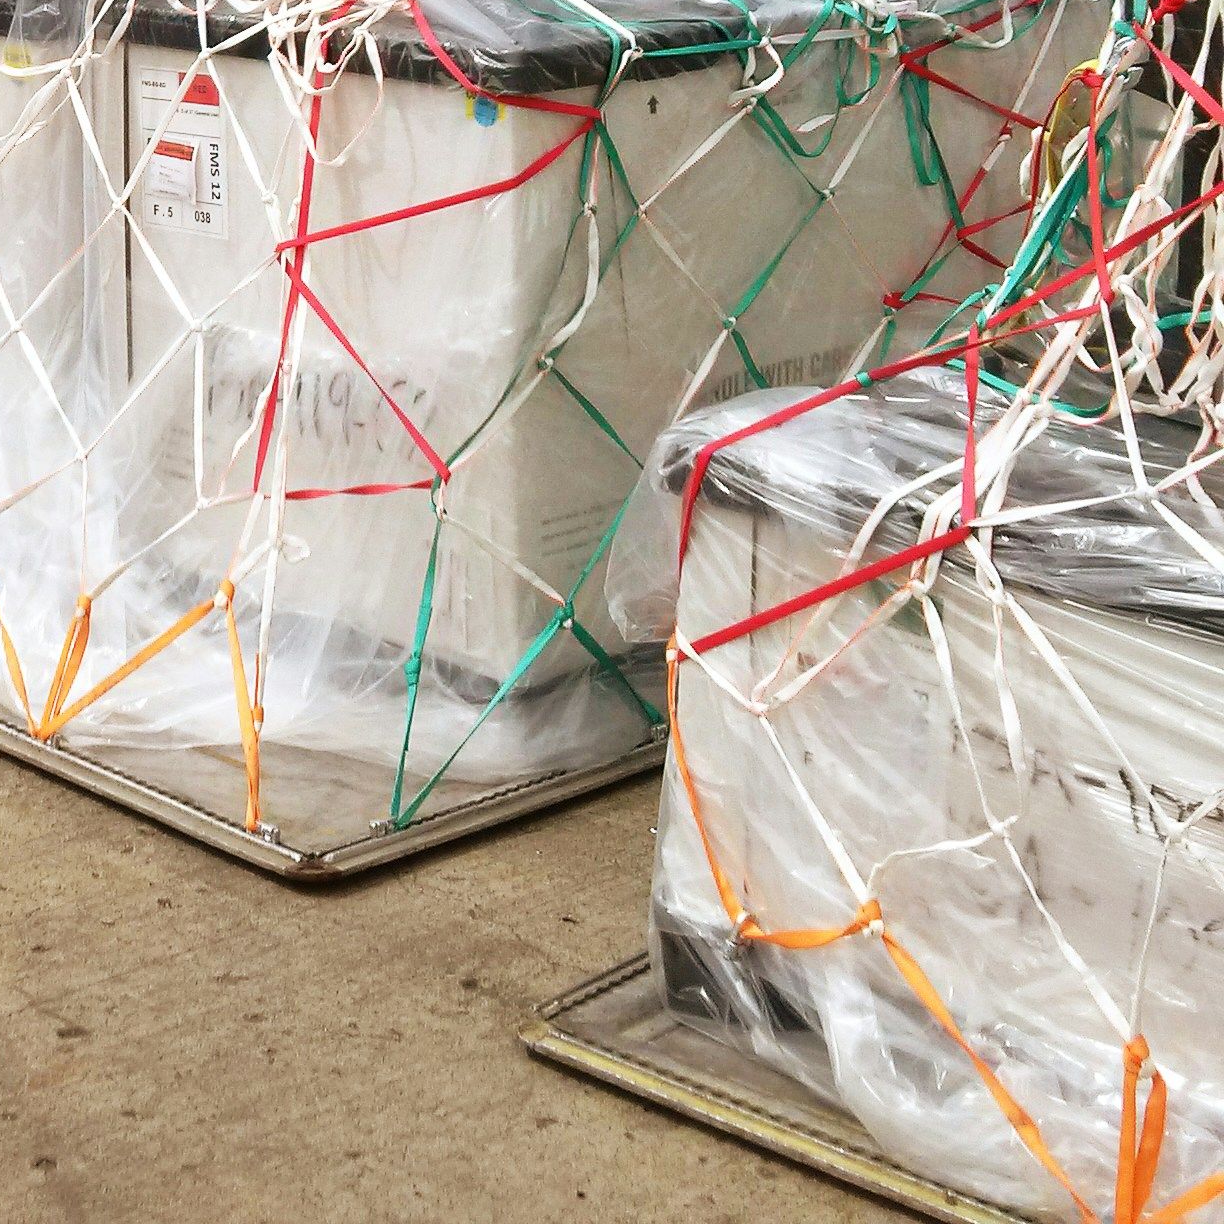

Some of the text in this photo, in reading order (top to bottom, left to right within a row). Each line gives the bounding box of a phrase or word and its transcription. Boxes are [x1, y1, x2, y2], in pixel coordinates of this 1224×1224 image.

[209, 143, 221, 200] FMS 12
[194, 210, 211, 224] 038
